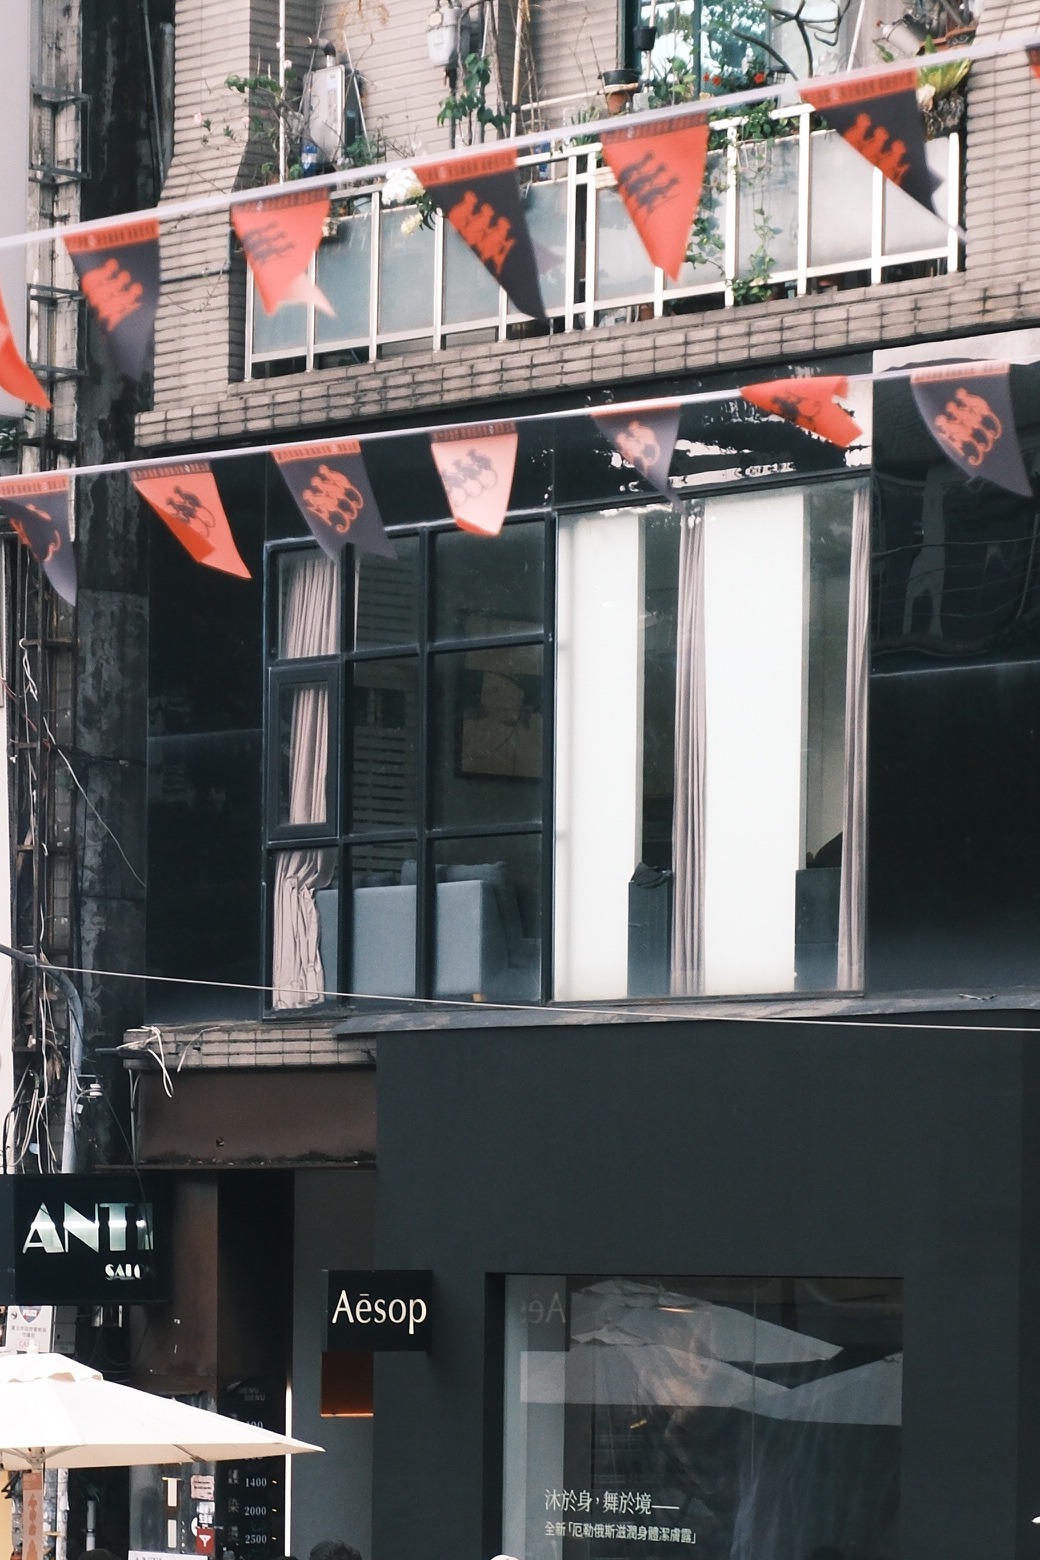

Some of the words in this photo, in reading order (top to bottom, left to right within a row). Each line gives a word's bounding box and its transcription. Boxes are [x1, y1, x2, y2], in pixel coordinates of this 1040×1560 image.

[22, 1202, 154, 1254] ANTI
[104, 1263, 150, 1281] SALO
[245, 1478, 267, 1488] 1400
[244, 1507, 267, 1516] 2000
[245, 1535, 267, 1544] 2500
